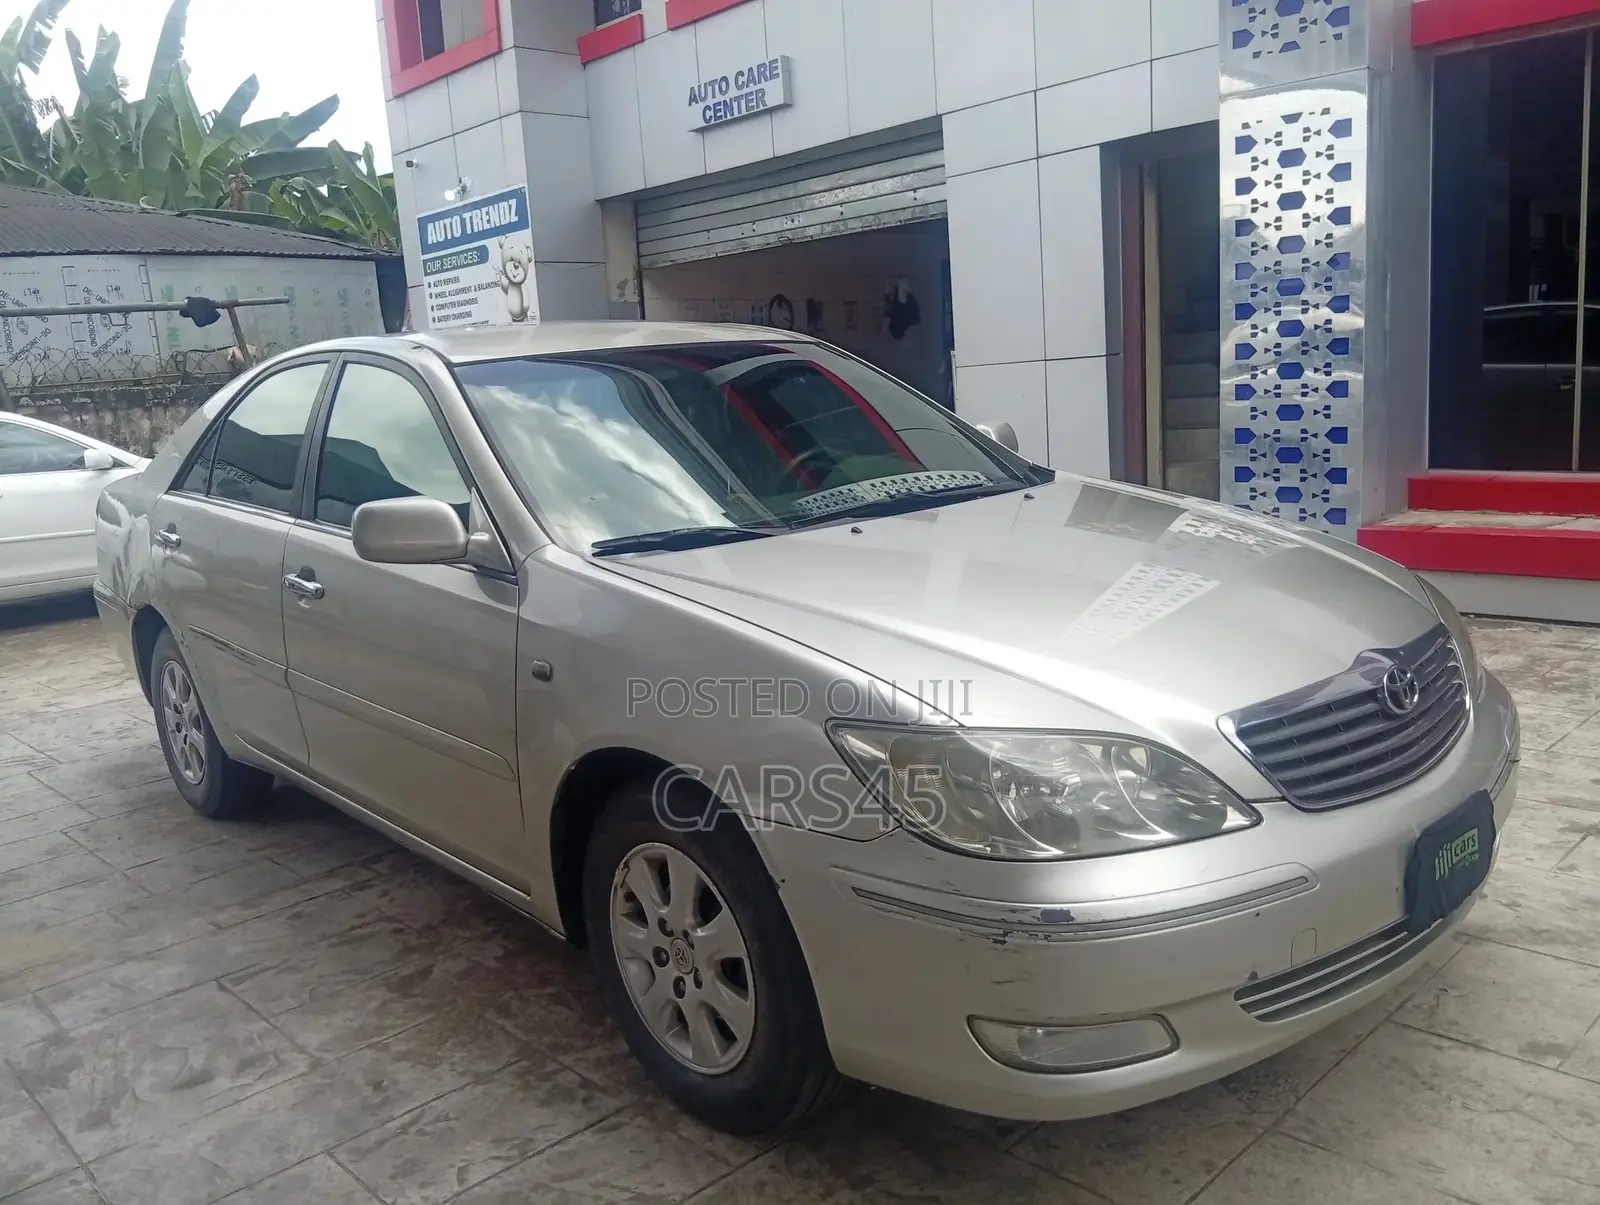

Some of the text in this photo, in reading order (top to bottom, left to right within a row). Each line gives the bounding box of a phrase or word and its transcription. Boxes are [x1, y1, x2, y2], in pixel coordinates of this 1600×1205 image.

[688, 58, 780, 107] AUTO CARE
[702, 87, 768, 125] CENTER
[427, 198, 519, 245] AUTO TRENDZ
[426, 259, 442, 273] OUR
[443, 276, 460, 286] REPAIRS
[435, 300, 457, 311] COMPUTER
[1454, 834, 1476, 857] cars
